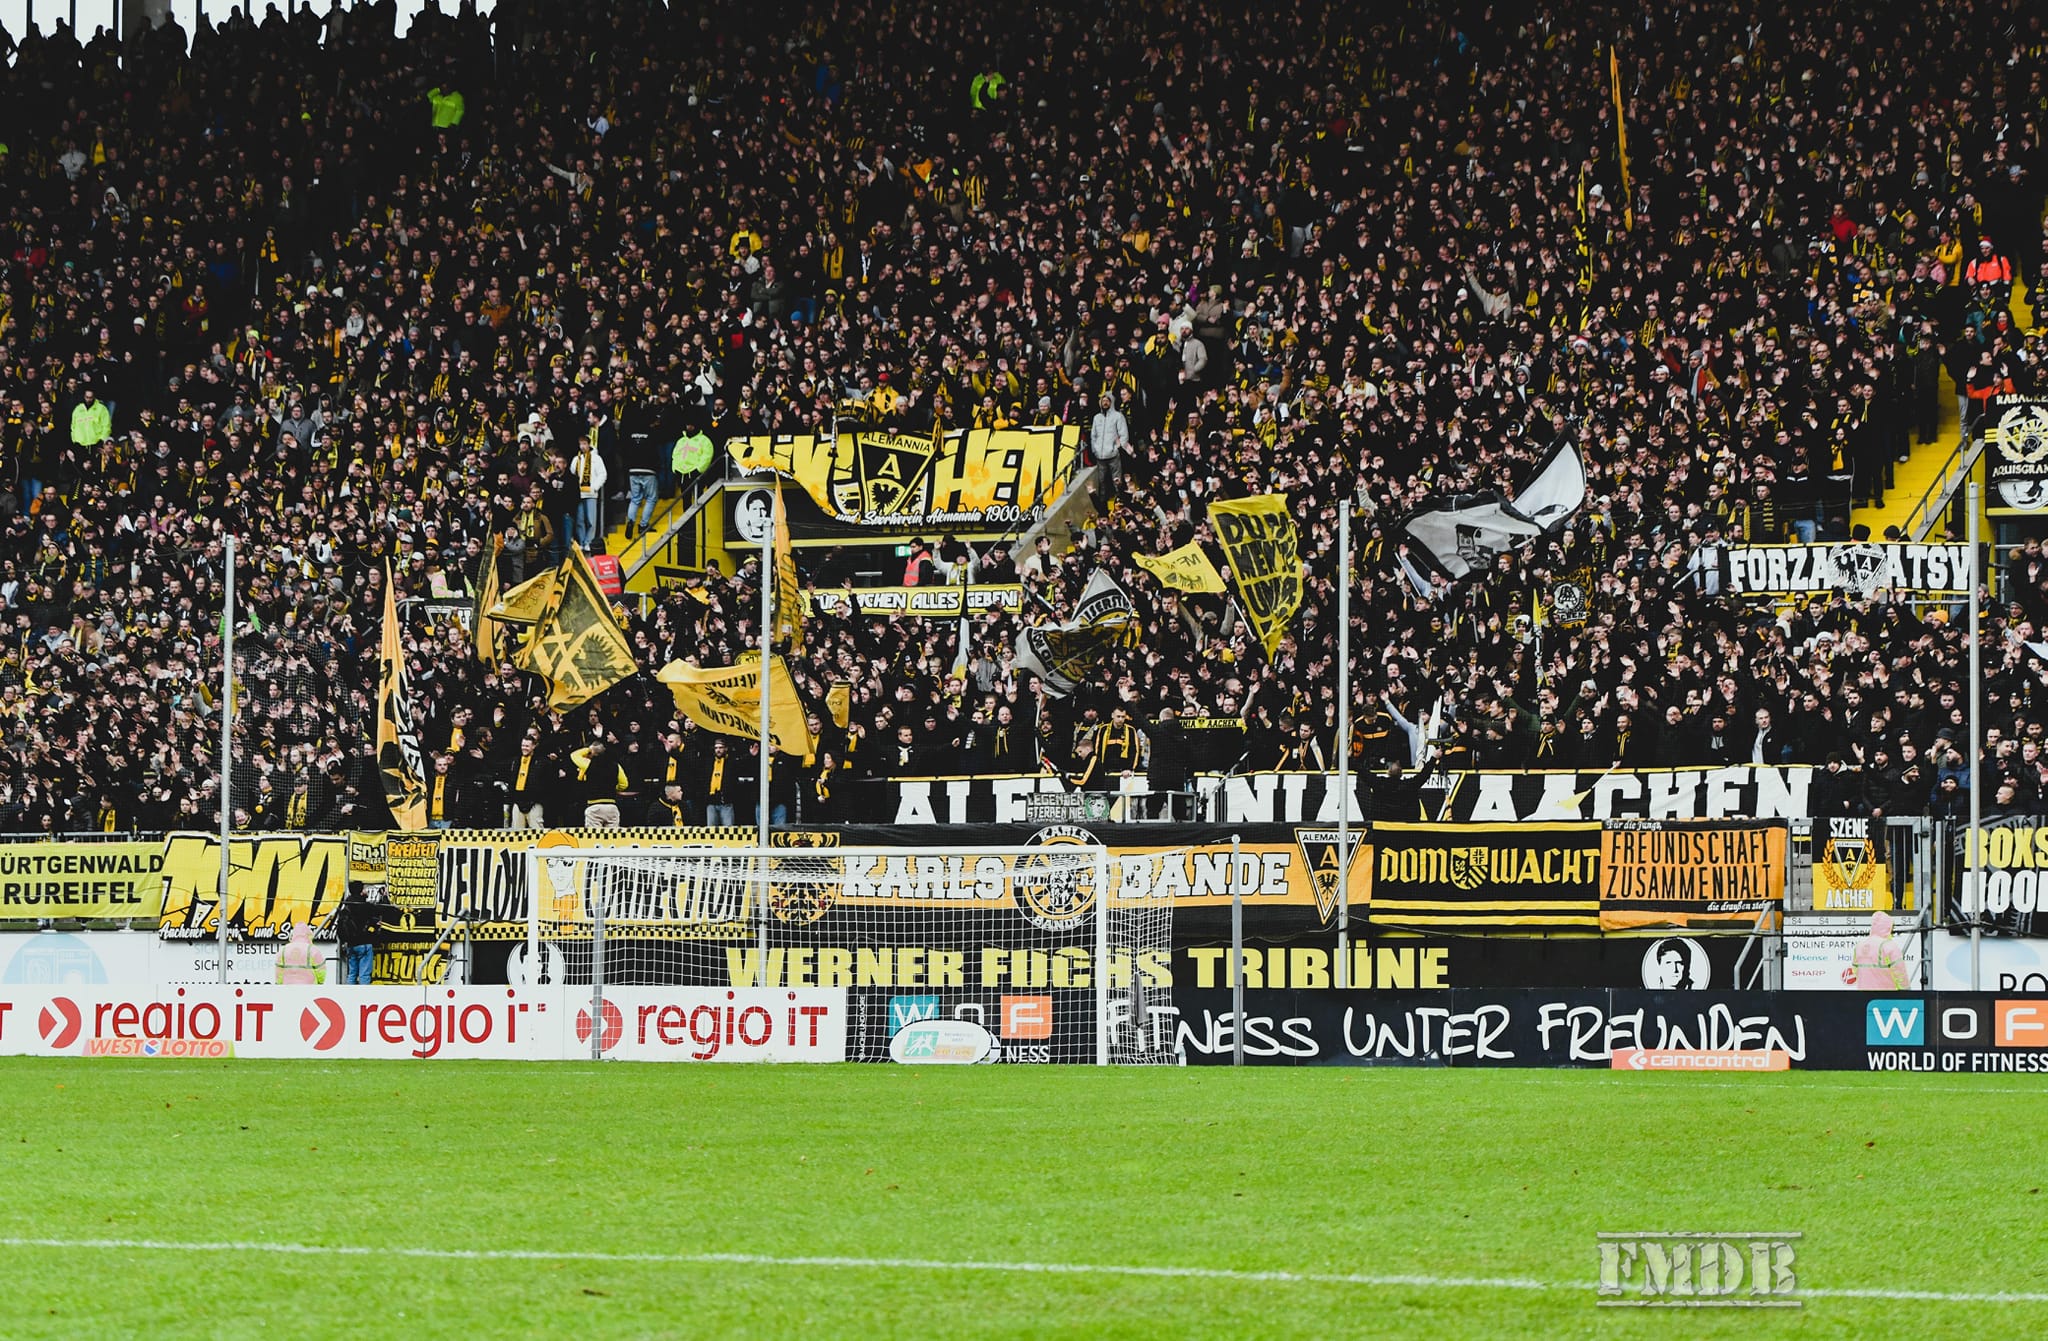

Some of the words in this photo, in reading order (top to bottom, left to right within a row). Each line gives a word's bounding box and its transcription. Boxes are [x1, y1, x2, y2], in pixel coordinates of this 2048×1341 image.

[861, 431, 932, 453] ALEMANNIA
[876, 452, 902, 479] A
[985, 505, 1020, 522] 1900
[1729, 547, 1833, 593] FORZA
[1885, 545, 1972, 591] ATSV
[911, 592, 960, 610] ALLES
[966, 590, 1018, 608] GEBEN!
[1039, 826, 1091, 842] KARLS
[1302, 833, 1358, 842] ALEMANIA
[1829, 817, 1869, 838] SZENE
[388, 842, 438, 858] FREIHEIT
[1611, 830, 1769, 865] FREUNDSCHAFT
[842, 855, 1006, 900] KARLS
[1119, 851, 1290, 899] BANDE
[1606, 864, 1771, 900] ZUSAMMENHALT
[7, 881, 142, 905] RUREIFEL
[1825, 889, 1873, 909] AACHEN
[254, 925, 274, 939] und
[1032, 917, 1083, 932] BANDE
[1791, 940, 1857, 949] ONLINE-PARTN
[194, 959, 234, 971] SICHR
[727, 947, 964, 988] WERNER
[984, 946, 1174, 989] FUCHS
[1188, 940, 1450, 989] TRIBÜNE
[359, 989, 494, 1058] regio
[638, 991, 773, 1061] regio
[1342, 1004, 1516, 1060] UNTER
[1536, 1001, 1806, 1062] FREUNDEN
[89, 1039, 143, 1055] WEST
[161, 1041, 225, 1057] LOTTO
[1650, 1052, 1771, 1069] camcontrol
[1867, 1052, 1935, 1071] WORLD
[1941, 1052, 1966, 1071] OF
[1971, 1053, 2048, 1073] FITNESS
